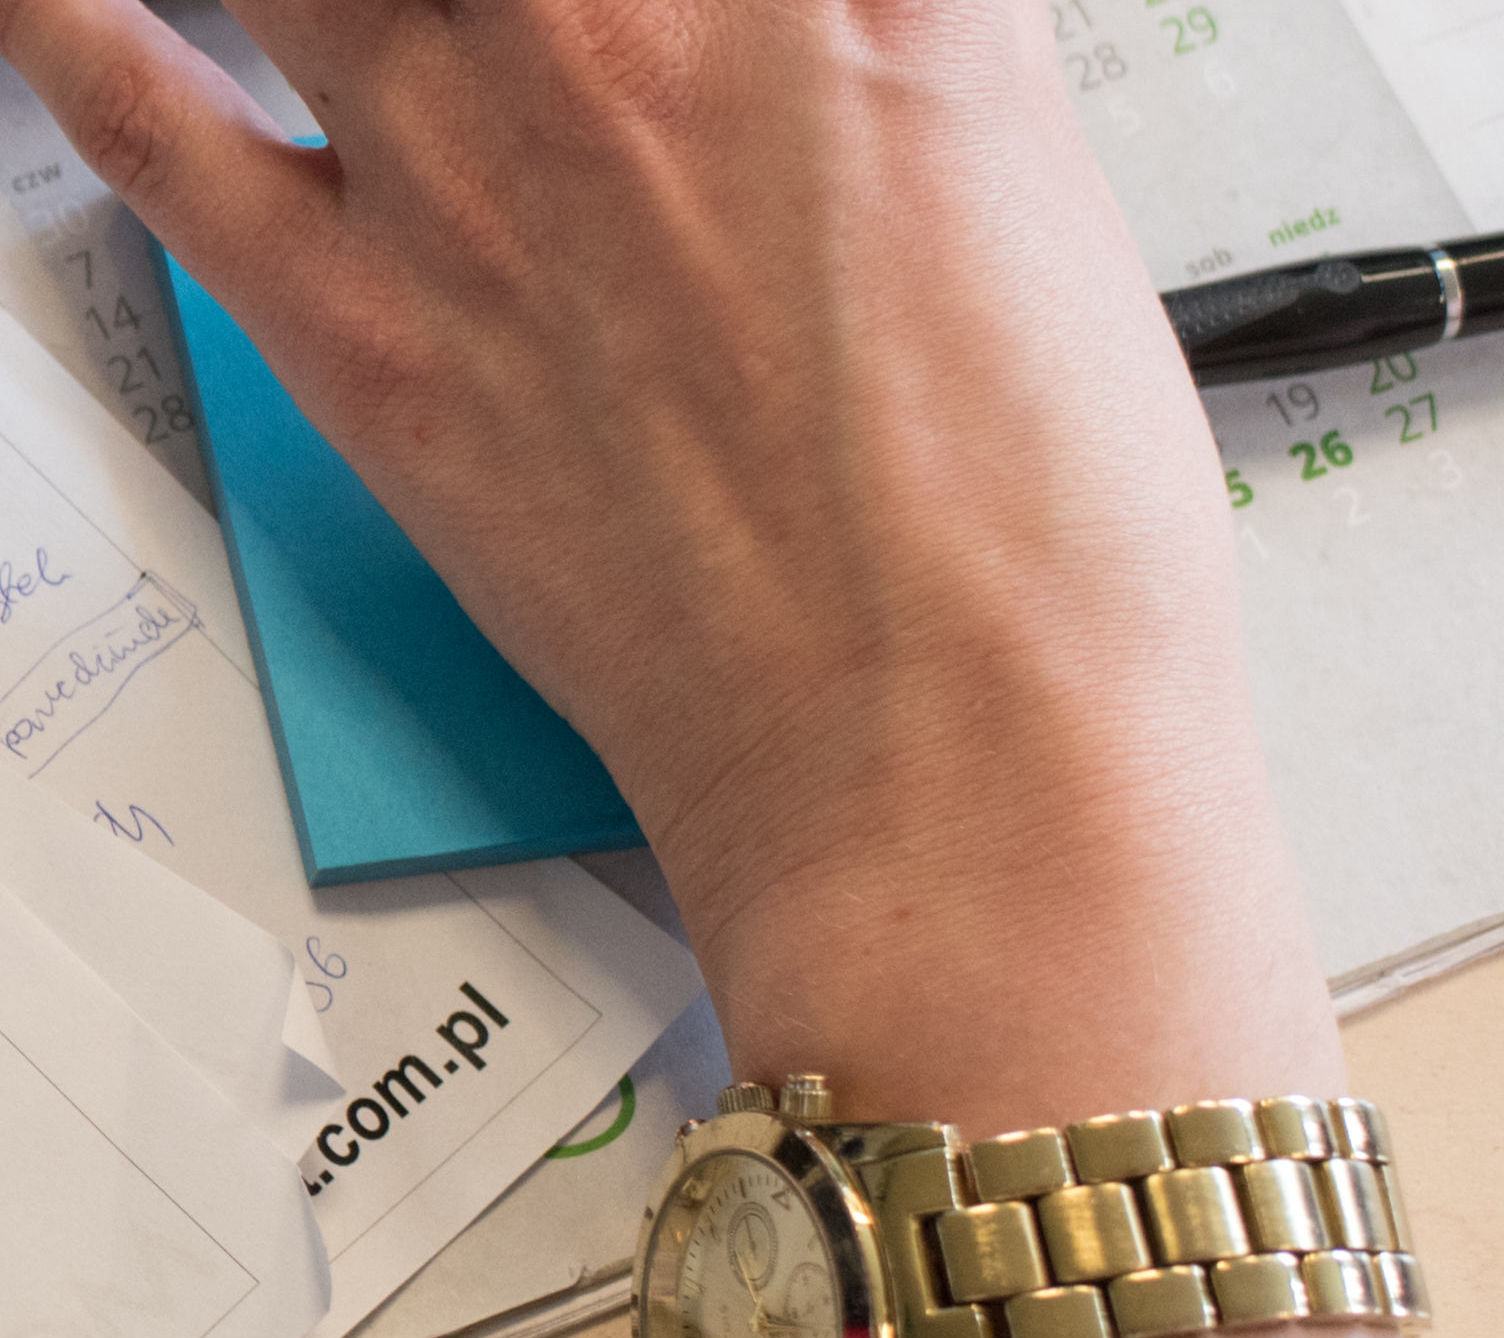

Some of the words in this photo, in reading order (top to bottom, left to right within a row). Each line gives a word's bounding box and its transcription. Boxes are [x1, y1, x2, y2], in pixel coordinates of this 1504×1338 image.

[1160, 5, 1219, 58] 29
[1265, 203, 1343, 250] niedz
[1385, 391, 1443, 445] 27
[1288, 427, 1354, 484] 26
